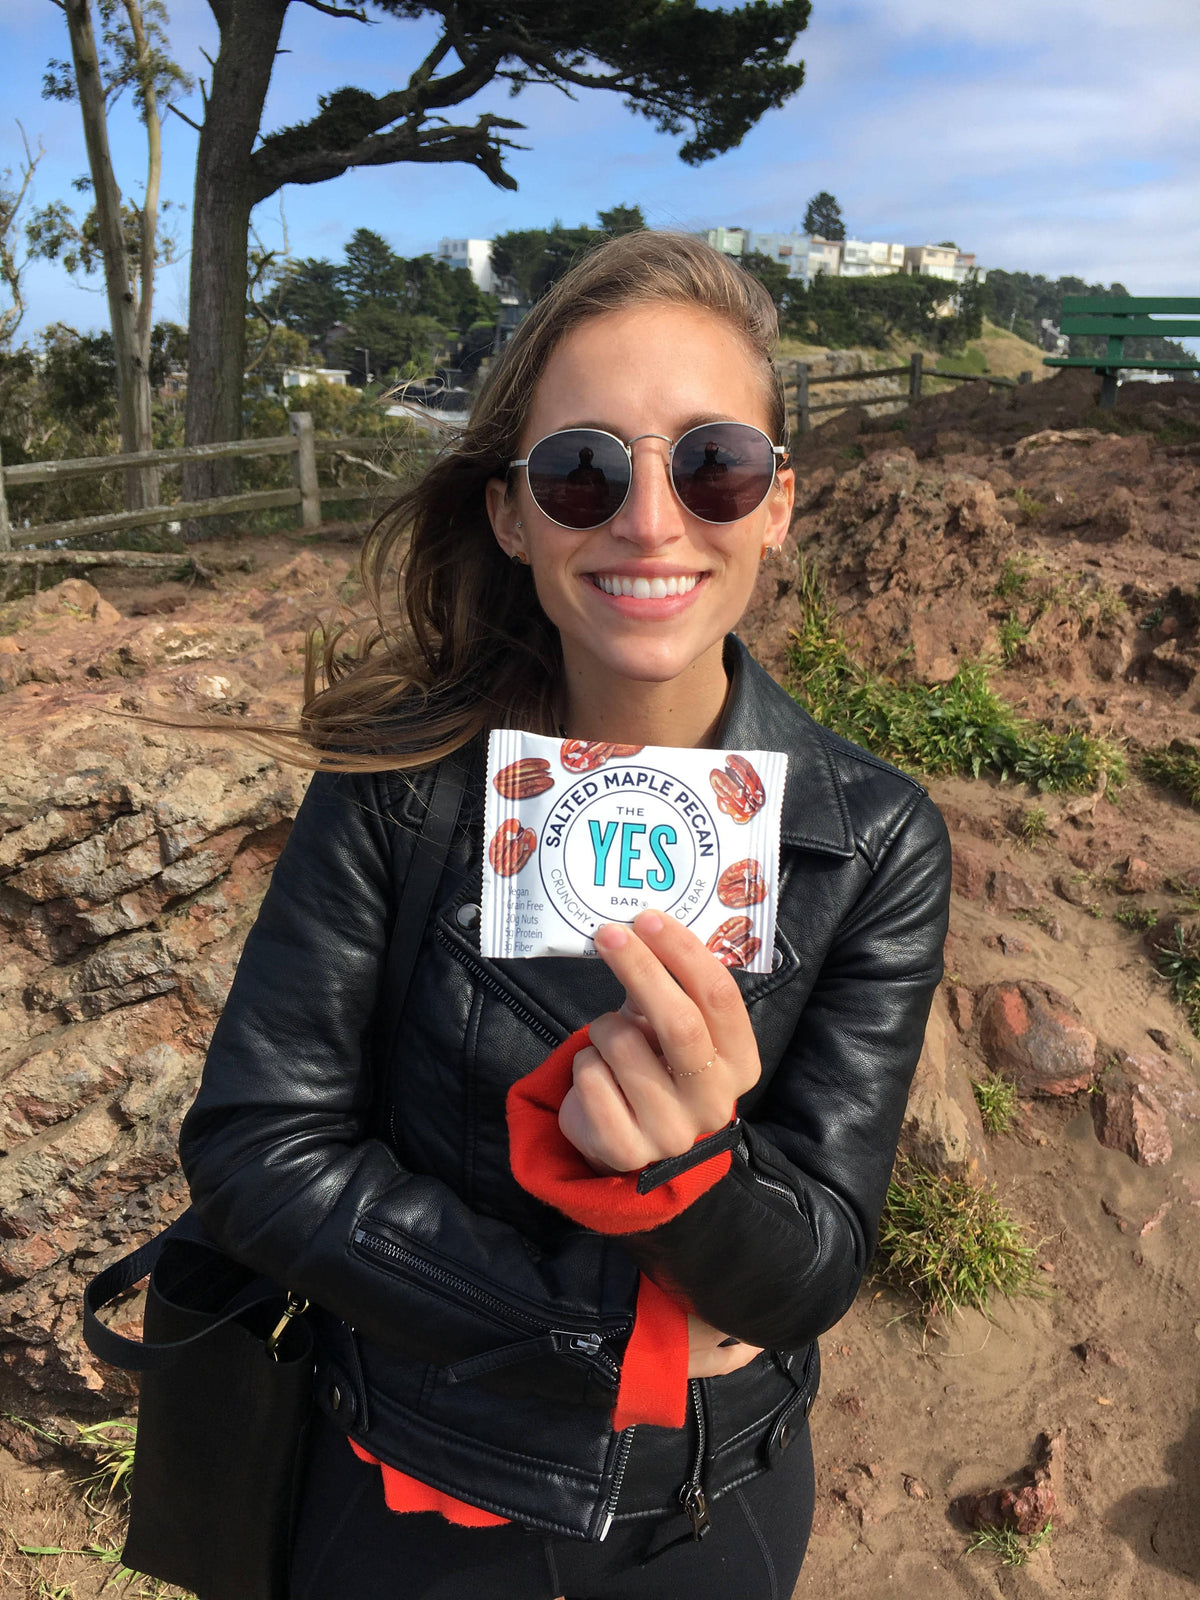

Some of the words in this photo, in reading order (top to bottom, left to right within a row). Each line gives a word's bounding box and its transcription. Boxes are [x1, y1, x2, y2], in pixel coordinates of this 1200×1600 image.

[545, 782, 598, 848] SALTED
[603, 772, 674, 797] MAPLE
[674, 791, 714, 857] PECAN
[616, 806, 645, 816] THE
[588, 820, 677, 891] YES
[508, 886, 529, 898] Vegan
[551, 868, 592, 924] CRUNCHY
[675, 902, 693, 920] CK
[687, 879, 707, 904] BAR
[507, 899, 525, 910] Grain
[526, 900, 544, 911] Free
[521, 914, 539, 925] Nuts
[515, 928, 543, 939] Protein
[514, 941, 534, 952] Fiber
